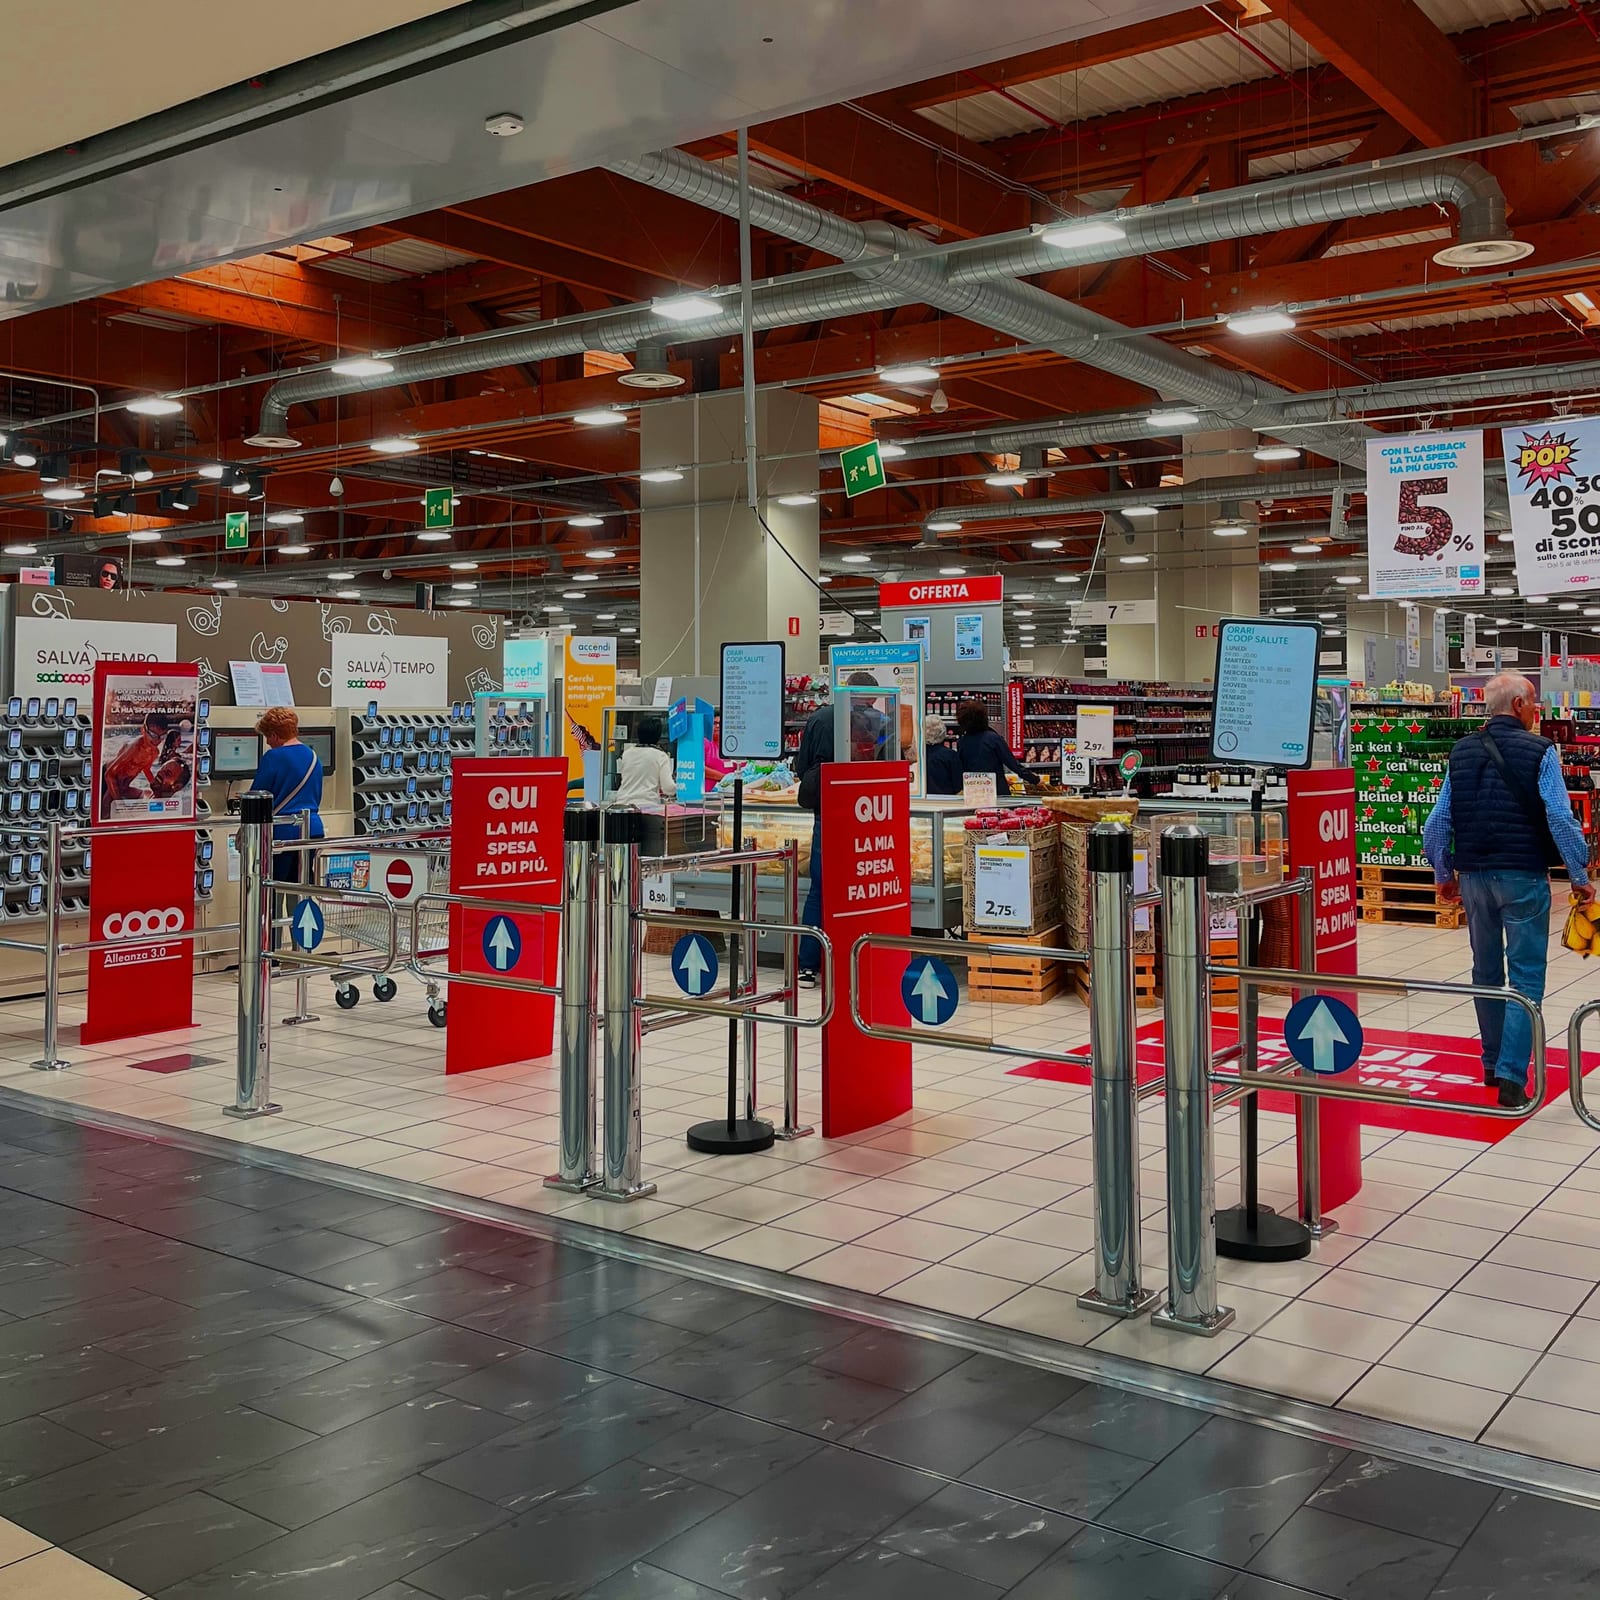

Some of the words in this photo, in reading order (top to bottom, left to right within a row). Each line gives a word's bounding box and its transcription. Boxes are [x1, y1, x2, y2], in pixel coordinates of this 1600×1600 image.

[1381, 448, 1402, 456] CON
[1413, 441, 1466, 453] CASHBACK
[1527, 437, 1561, 447] PREZZI
[1390, 457, 1402, 465] LA
[1404, 455, 1424, 463] TUA
[1425, 452, 1457, 462] SPESA
[1520, 445, 1571, 468] POP
[1389, 466, 1404, 474] HA
[1423, 461, 1458, 470] GUSTO.
[1530, 485, 1574, 509] 40
[1393, 477, 1453, 556] 5
[1453, 534, 1474, 552] %
[1551, 504, 1600, 537] 50
[1535, 538, 1553, 553] di
[1559, 550, 1588, 559] Grandi
[1460, 579, 1480, 588] coop
[909, 583, 969, 600] OFFERTA
[1108, 605, 1117, 619] 7
[1227, 626, 1255, 634] ORARI
[578, 643, 611, 651] accendi
[1226, 634, 1253, 643] COOP
[1255, 635, 1289, 645] SALUTE
[36, 650, 91, 665] SALVA
[1486, 650, 1493, 659] 6
[347, 660, 386, 674] SALVA
[393, 662, 435, 675] TEMPO
[36, 670, 91, 686] sociocoop
[568, 674, 594, 682] Cerchi
[568, 693, 605, 702] energia?
[1282, 742, 1304, 752] coop
[1069, 762, 1083, 770] 50
[488, 786, 538, 810] QUI
[854, 794, 893, 822] QUI
[486, 822, 507, 836] LA
[511, 820, 539, 834] MIA
[1319, 808, 1349, 842] QUI
[487, 841, 537, 855] SPESA
[854, 837, 872, 852] LA
[875, 835, 895, 850] MIA
[476, 862, 498, 876] FA
[501, 861, 517, 874] DI
[856, 858, 894, 876] SPESA
[1319, 860, 1334, 879] LA
[1335, 856, 1350, 876] MIA
[649, 889, 665, 903] 8,90
[848, 884, 866, 900] FA
[869, 883, 881, 898] DI
[1320, 885, 1350, 907] SPESA
[1315, 917, 1329, 936] FA
[1331, 915, 1341, 932] DI
[104, 950, 148, 965] Alleanza
[150, 947, 166, 959] 3.0
